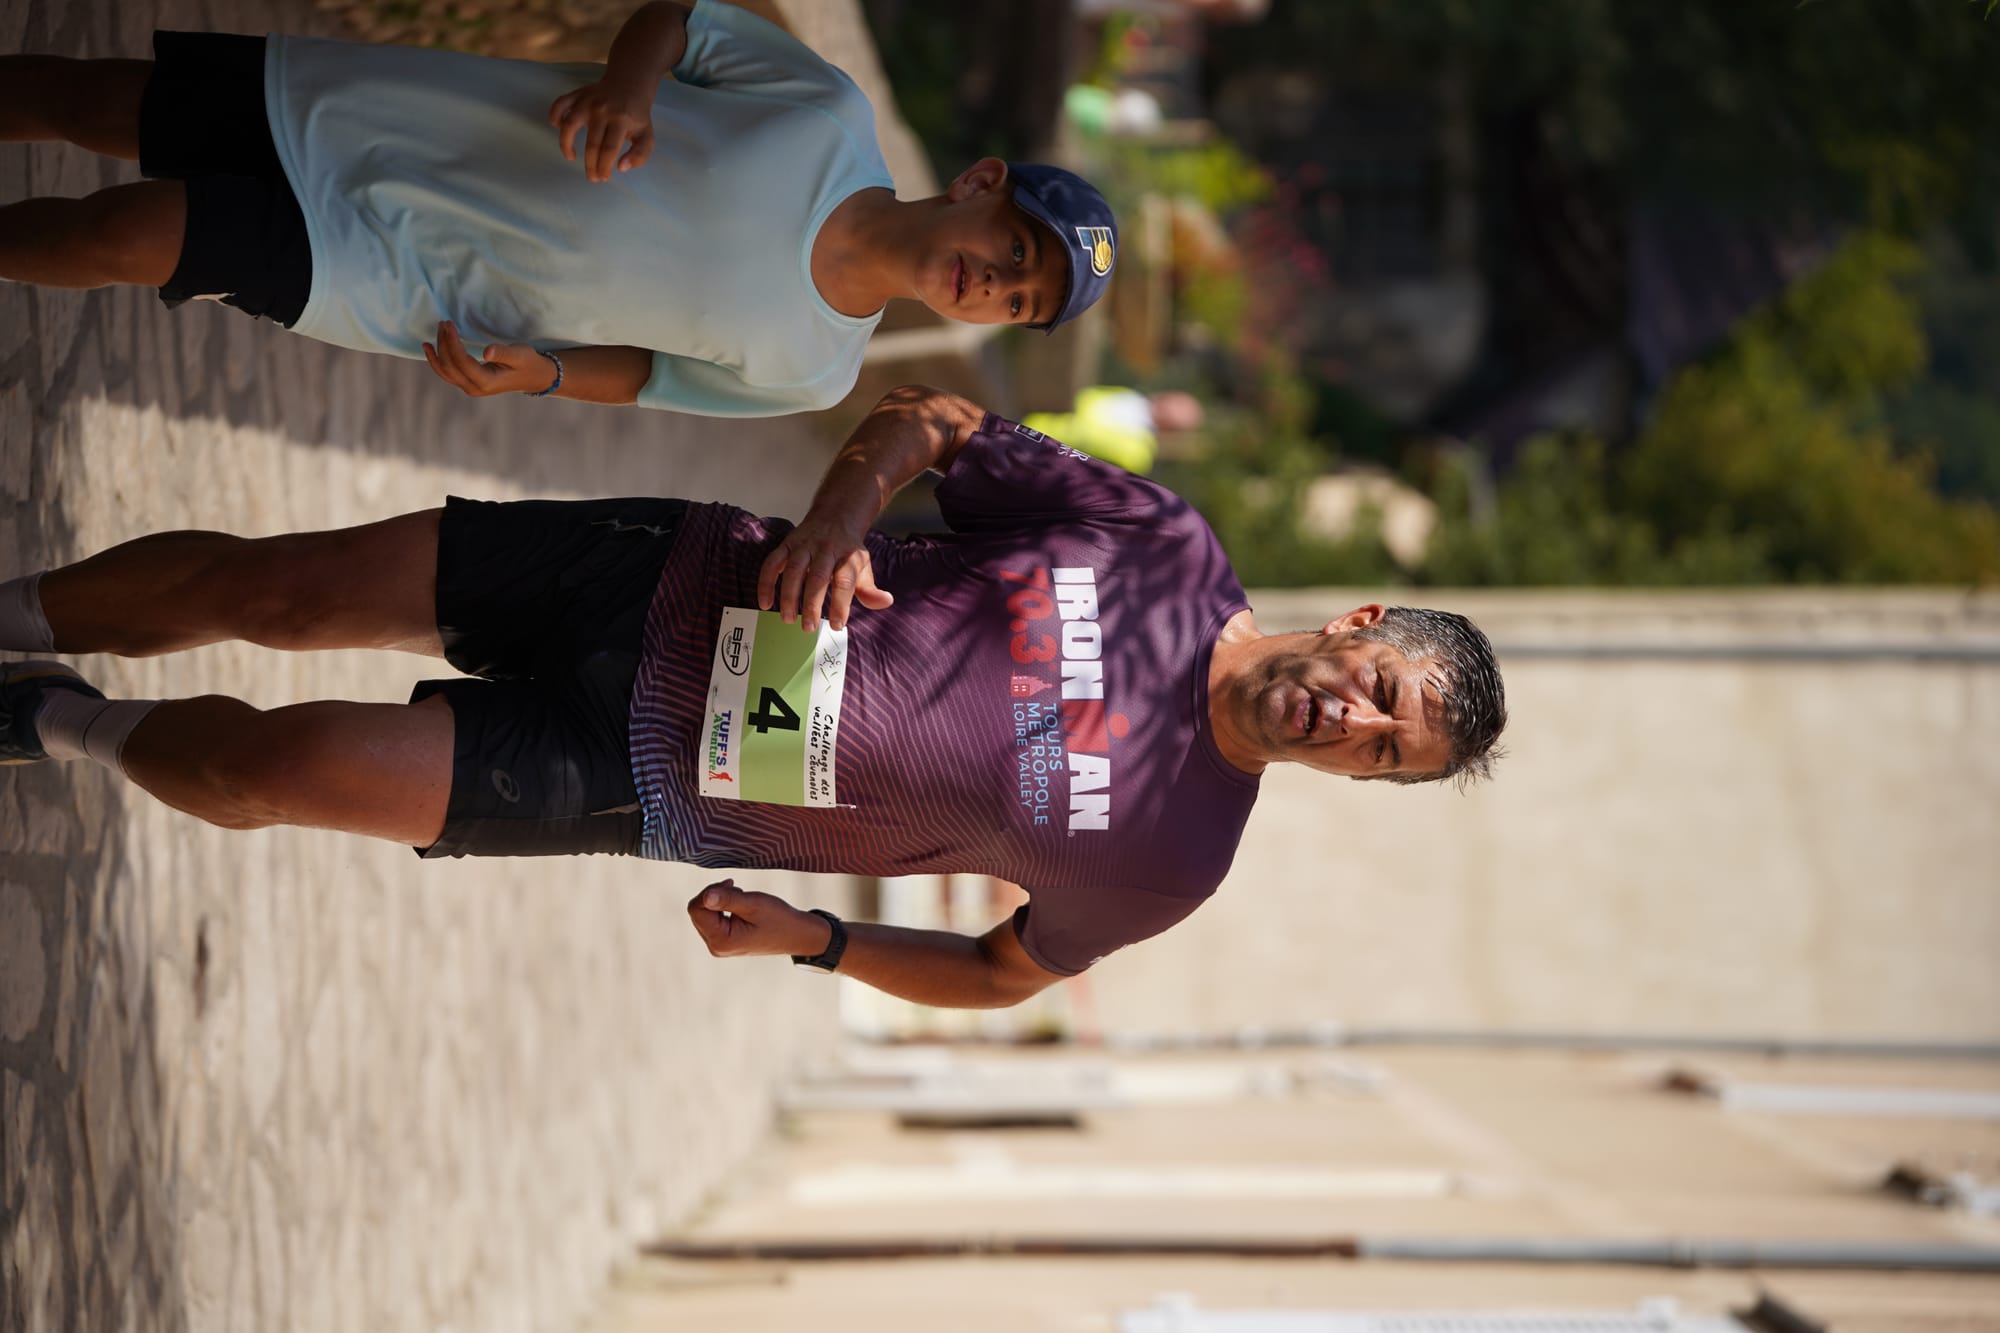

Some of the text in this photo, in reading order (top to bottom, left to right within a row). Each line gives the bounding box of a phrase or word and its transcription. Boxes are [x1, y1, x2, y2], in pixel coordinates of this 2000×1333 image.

[729, 627, 745, 668] BFP
[1000, 567, 1058, 665] 70.3
[716, 710, 732, 767] TUFF'S
[748, 686, 801, 734] 4
[1043, 703, 1063, 771] TOURS
[1051, 567, 1111, 831] IRONMAN
[708, 713, 723, 771] Aventure
[809, 706, 822, 801] vallées cévenoles
[818, 714, 834, 796] Challenge des
[1014, 703, 1032, 808] LOIRE VALLEY
[1027, 702, 1048, 825] MÉTROPOLE
